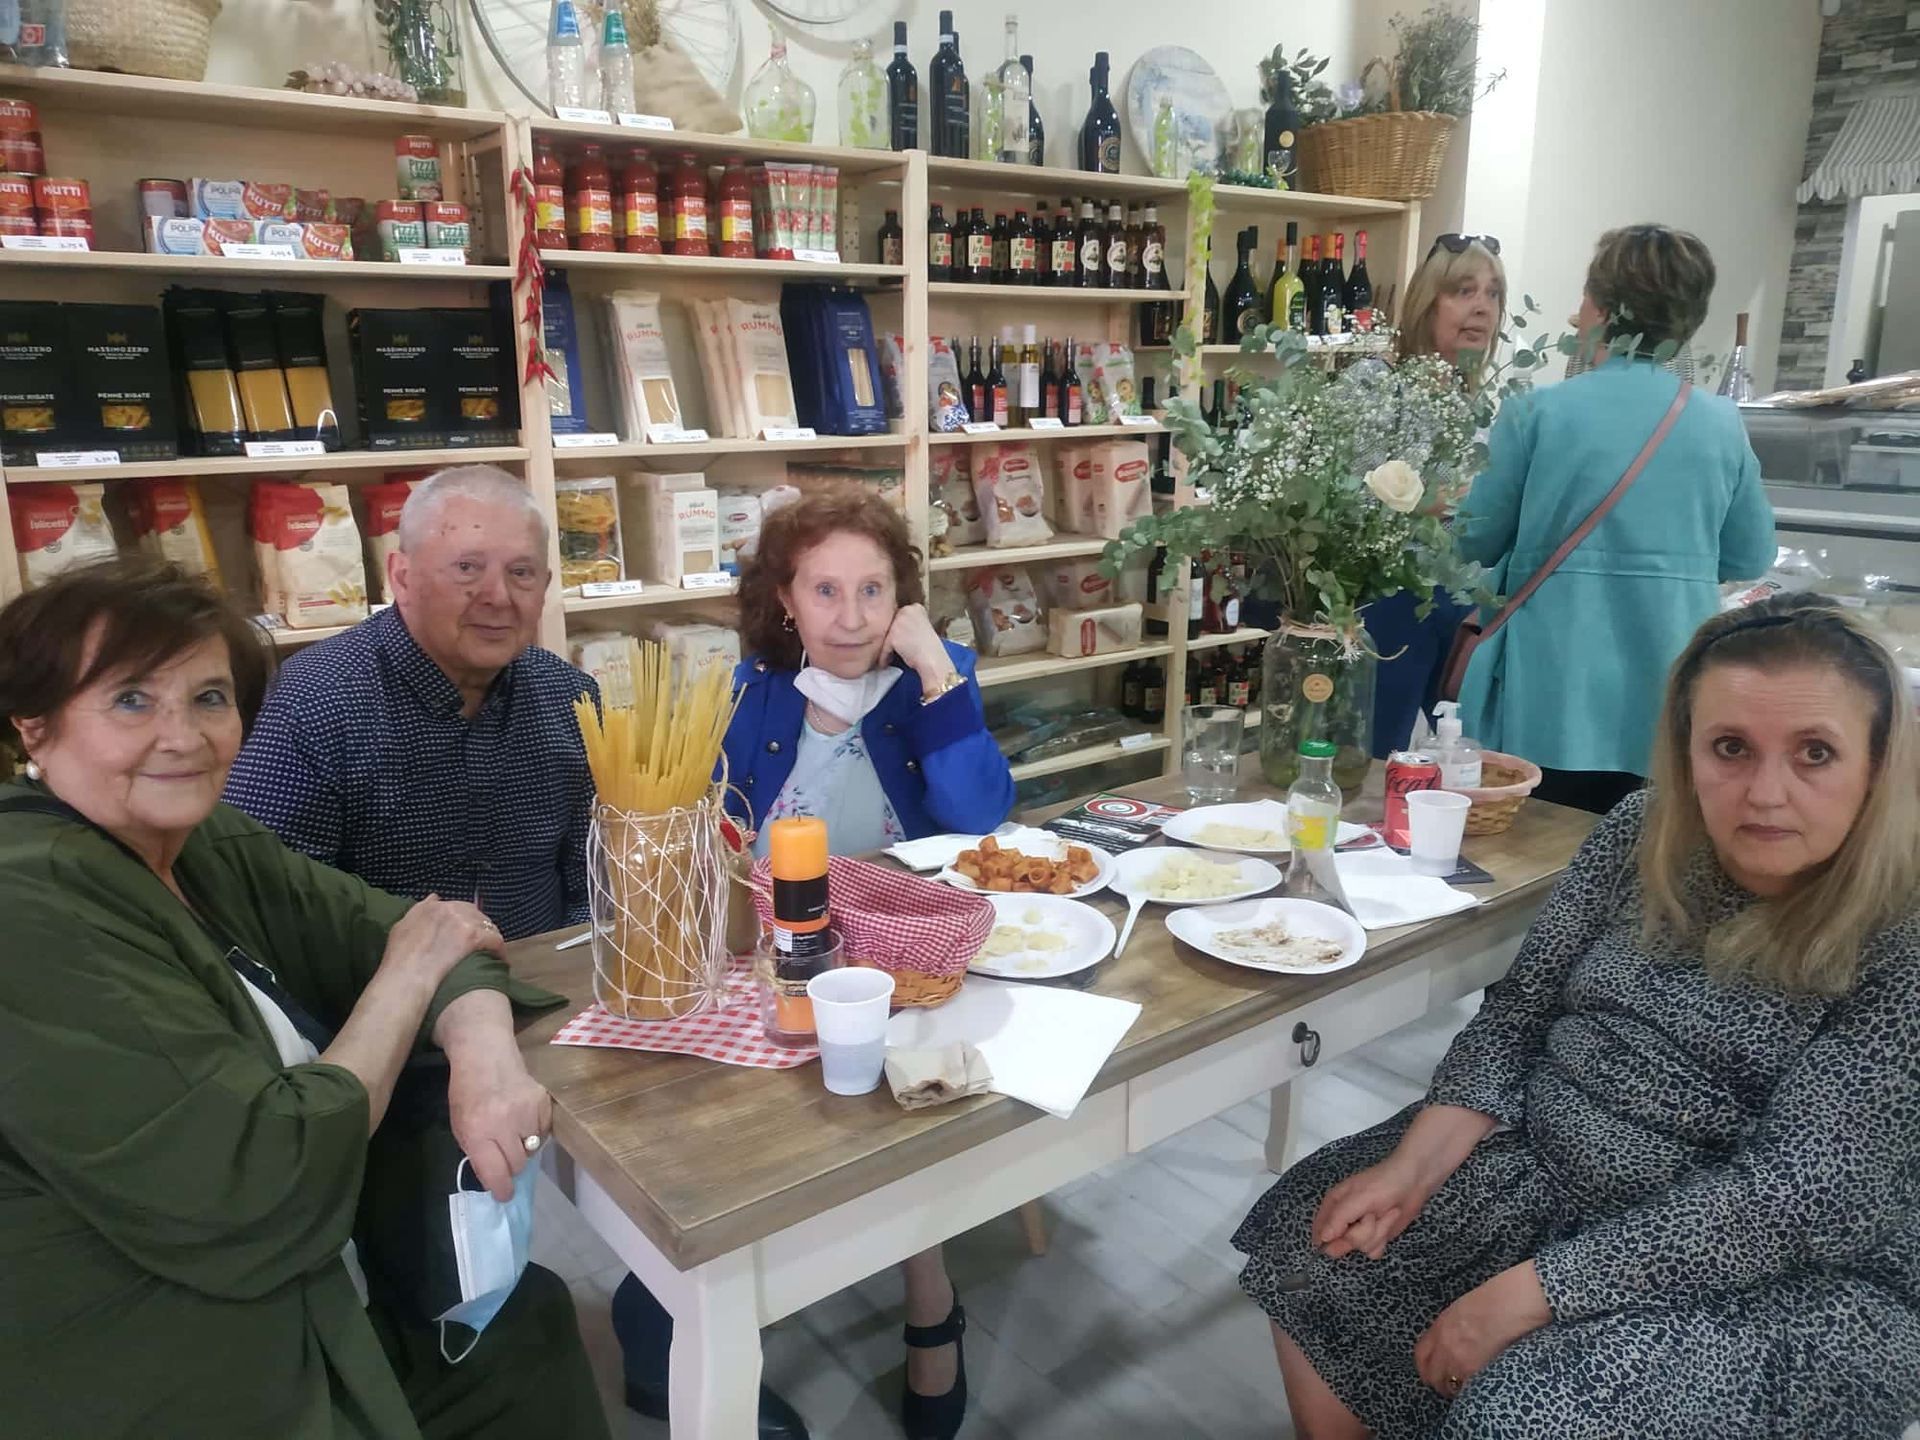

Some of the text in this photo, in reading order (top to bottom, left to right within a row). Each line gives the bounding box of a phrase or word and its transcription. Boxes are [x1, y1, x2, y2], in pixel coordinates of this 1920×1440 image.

[409, 159, 436, 172] PIZZA
[306, 230, 340, 253] MUTTI
[740, 320, 783, 337] RUMMO
[678, 509, 717, 521] RUMMO
